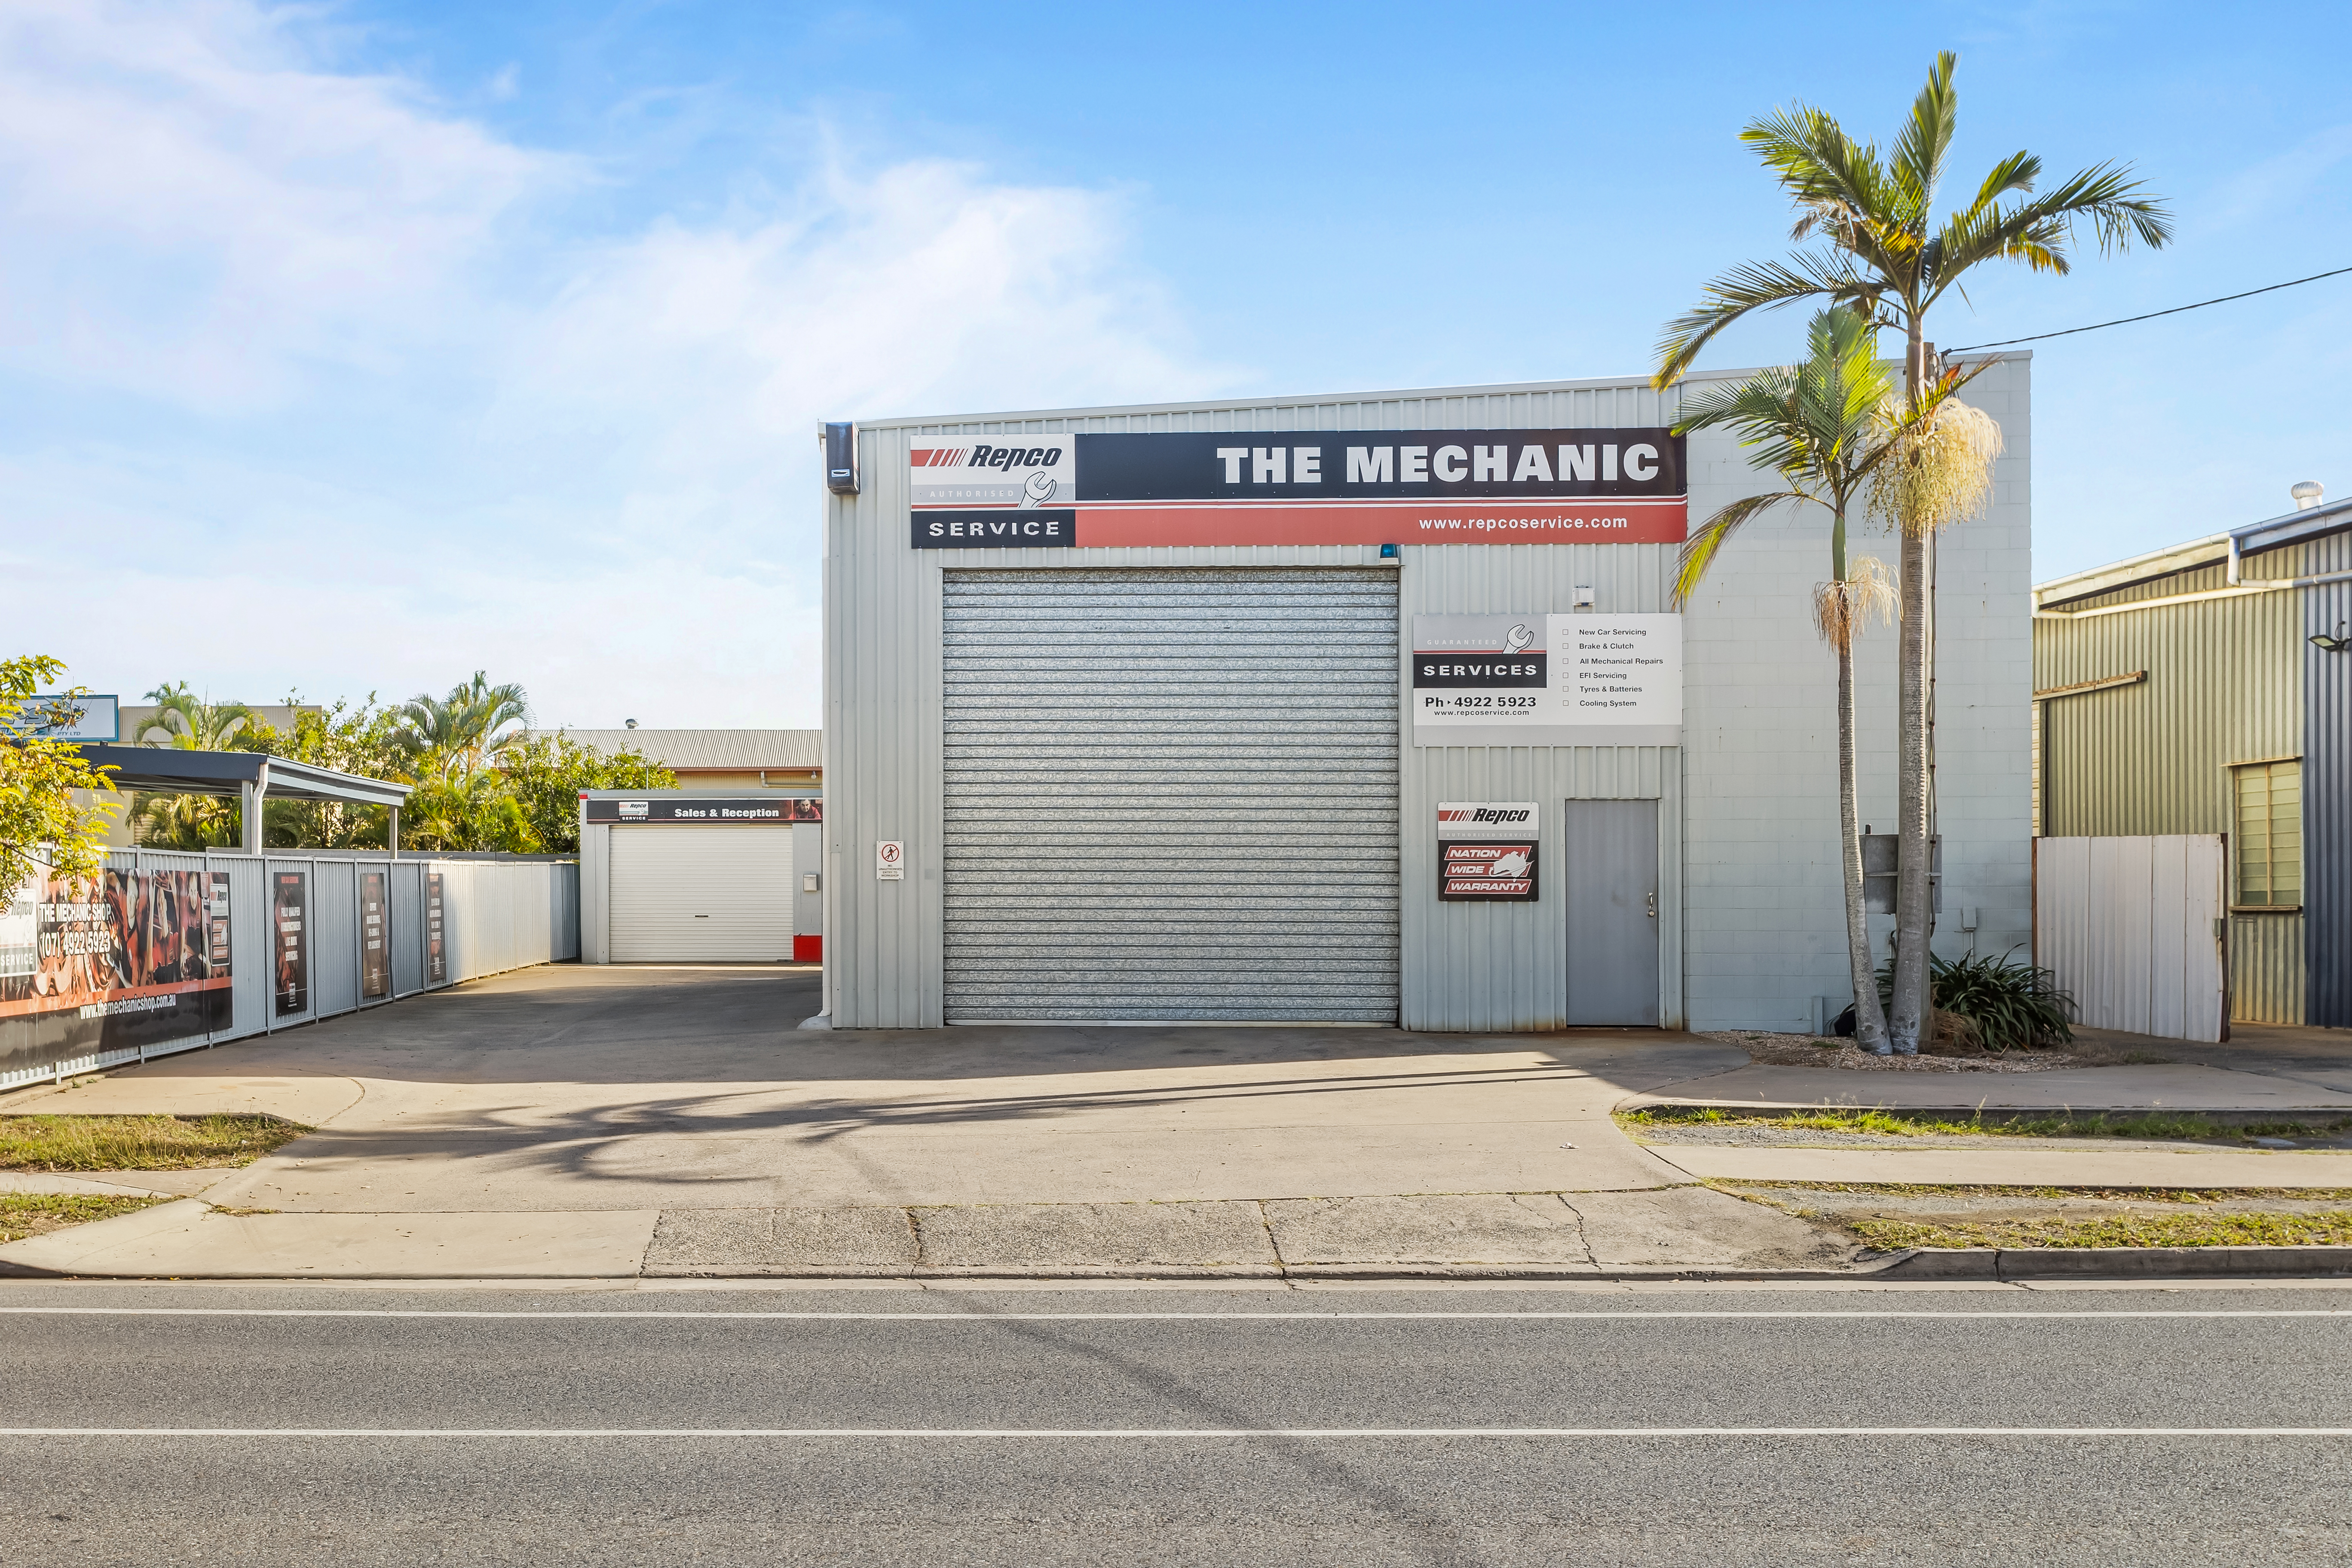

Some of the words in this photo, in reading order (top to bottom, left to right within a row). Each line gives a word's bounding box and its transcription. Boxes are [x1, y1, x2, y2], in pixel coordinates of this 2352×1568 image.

[968, 445, 1062, 472] Repco
[1217, 447, 1321, 484] THE
[1347, 443, 1659, 483] MECHANIC
[929, 521, 1059, 536] SERVICE
[1419, 515, 1627, 532] www.repcoservice.com
[1424, 665, 1537, 676] SERVICES
[1425, 697, 1444, 707] Ph
[1454, 697, 1492, 707] 4922
[1498, 697, 1536, 707] 5923
[674, 808, 706, 817] Sales
[709, 809, 718, 817] &
[722, 808, 779, 819] Reception
[1471, 808, 1530, 825] Repco
[1450, 849, 1501, 858] NATION
[40, 903, 55, 922] THE
[56, 903, 92, 922] MECHANIC
[92, 903, 111, 922] SHOP
[42, 932, 60, 959] (07)
[63, 931, 86, 956] 4922
[88, 930, 111, 954] 5923
[0, 953, 34, 966] SERVICE
[80, 992, 176, 1020] www.themechanicshop.com.au
